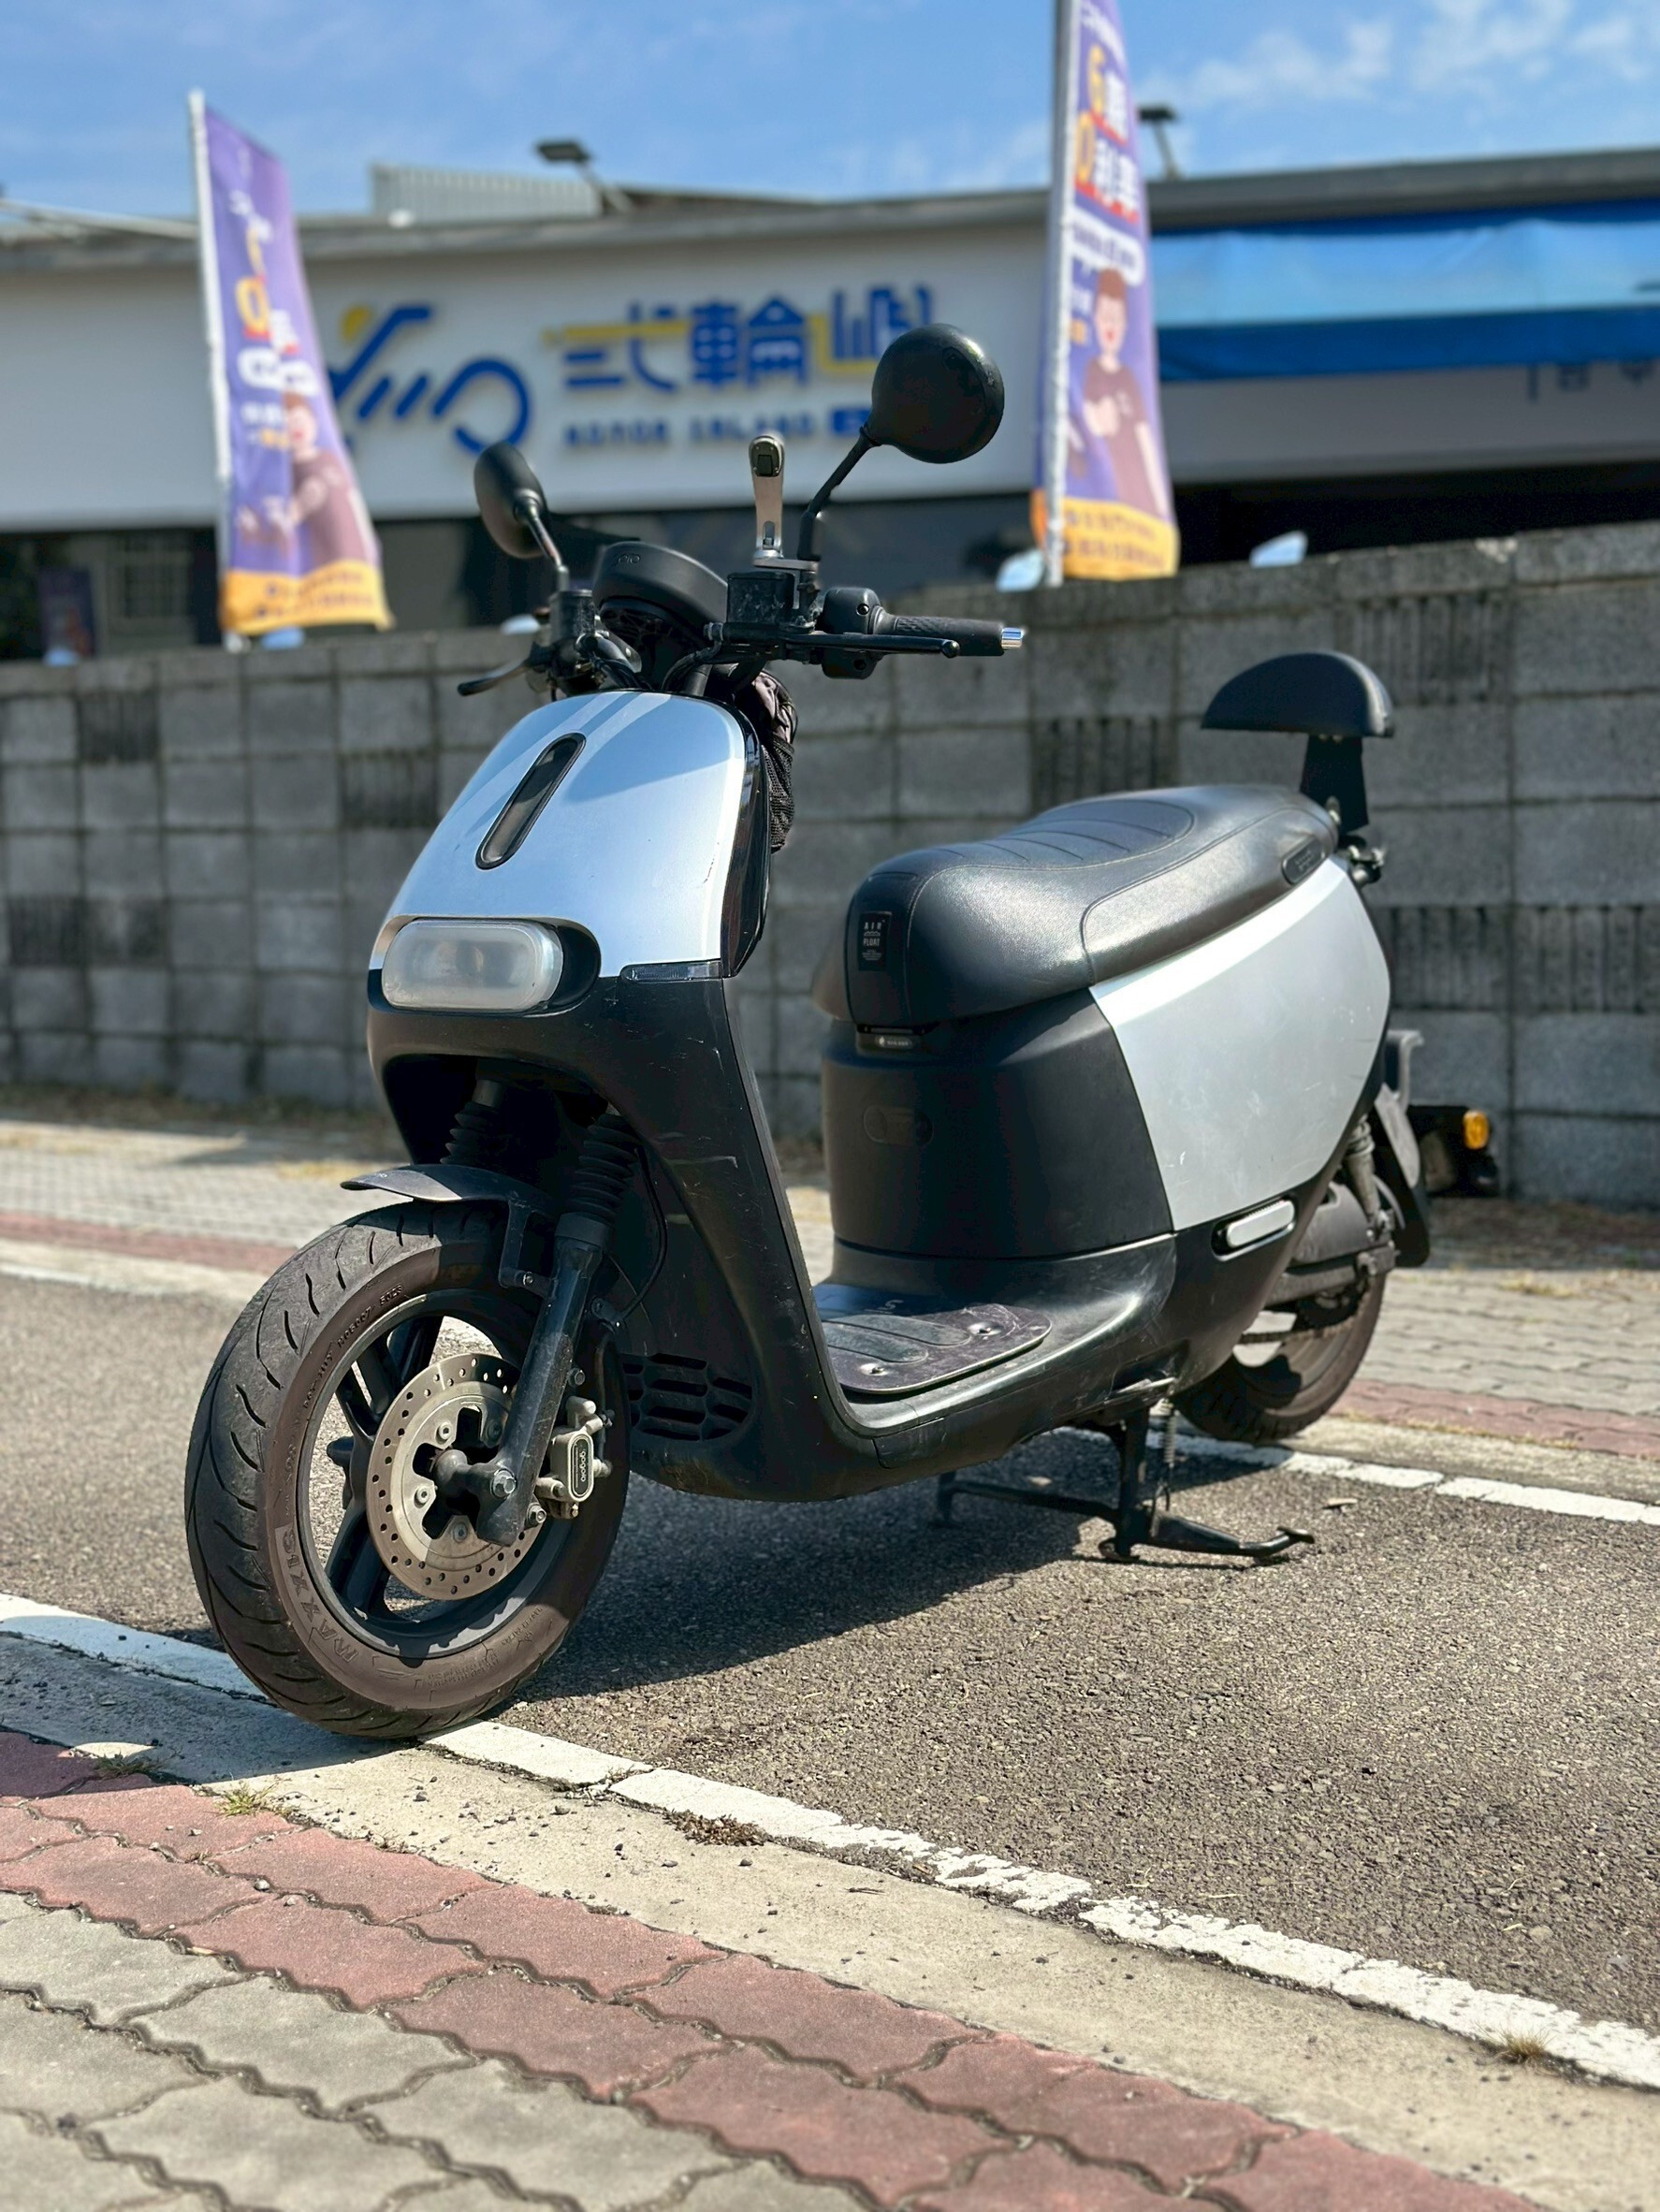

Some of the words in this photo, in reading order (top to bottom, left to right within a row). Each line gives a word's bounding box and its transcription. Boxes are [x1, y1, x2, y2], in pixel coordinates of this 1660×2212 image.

[864, 922, 882, 930] AIR
[863, 938, 881, 946] FLOAT
[283, 1528, 358, 1663] MAXXIS
